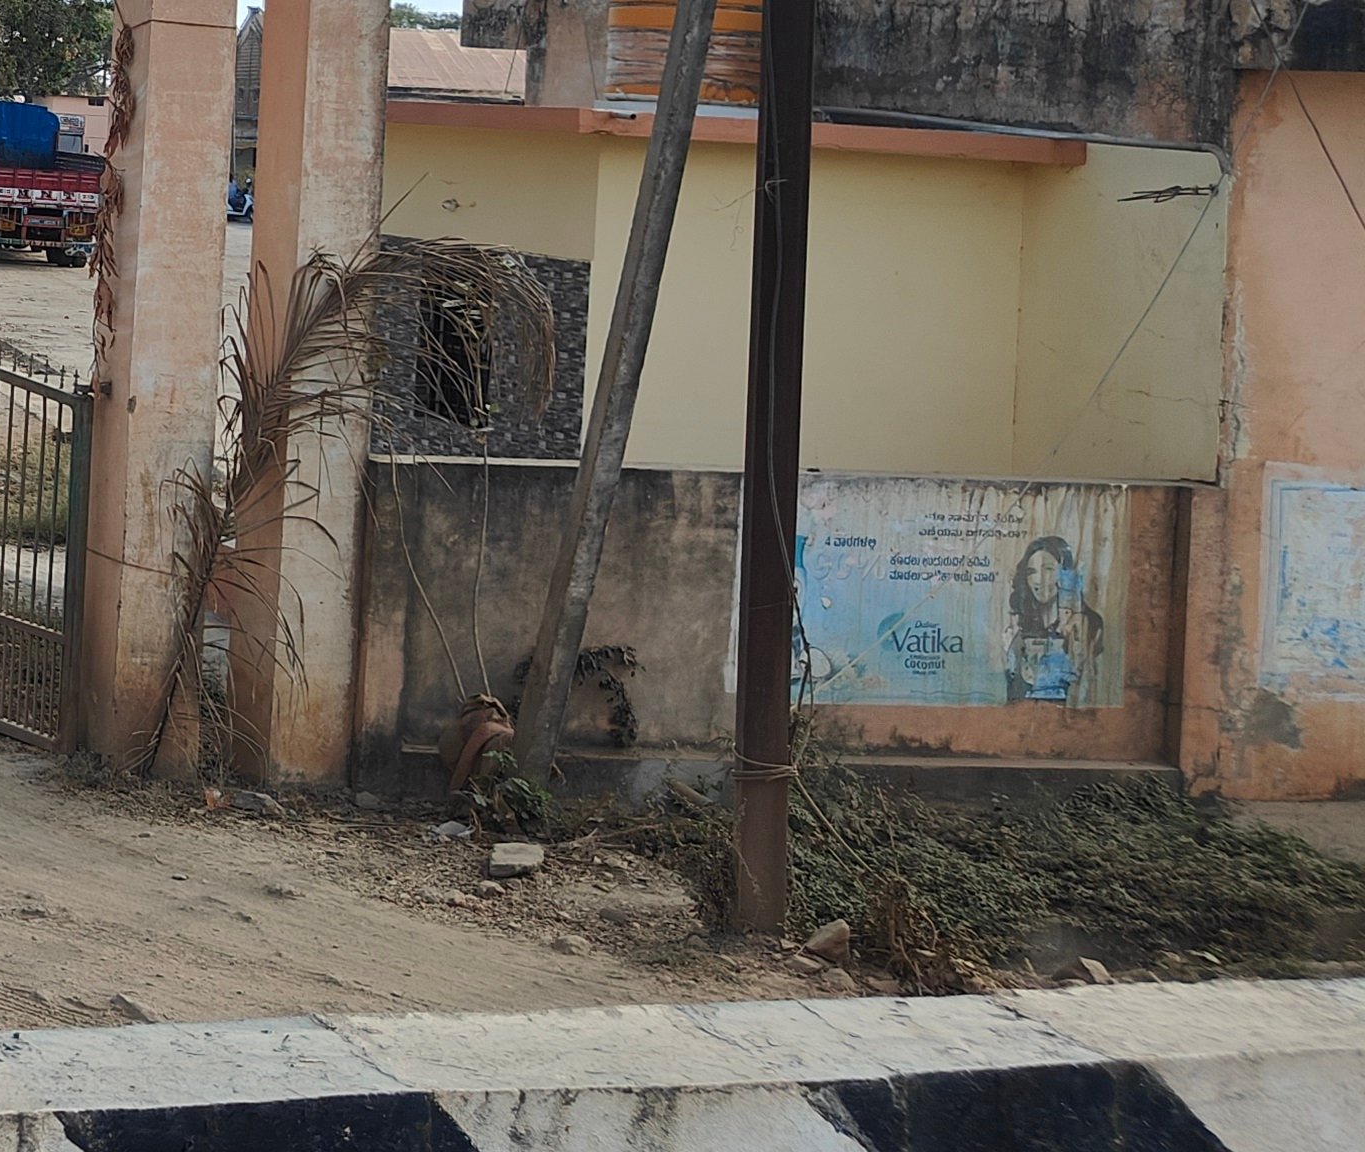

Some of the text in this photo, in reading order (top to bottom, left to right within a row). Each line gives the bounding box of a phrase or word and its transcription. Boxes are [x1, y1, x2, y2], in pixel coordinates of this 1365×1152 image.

[825, 536, 831, 546] 4
[892, 627, 964, 654] Vatika
[904, 658, 946, 669] Coconut
